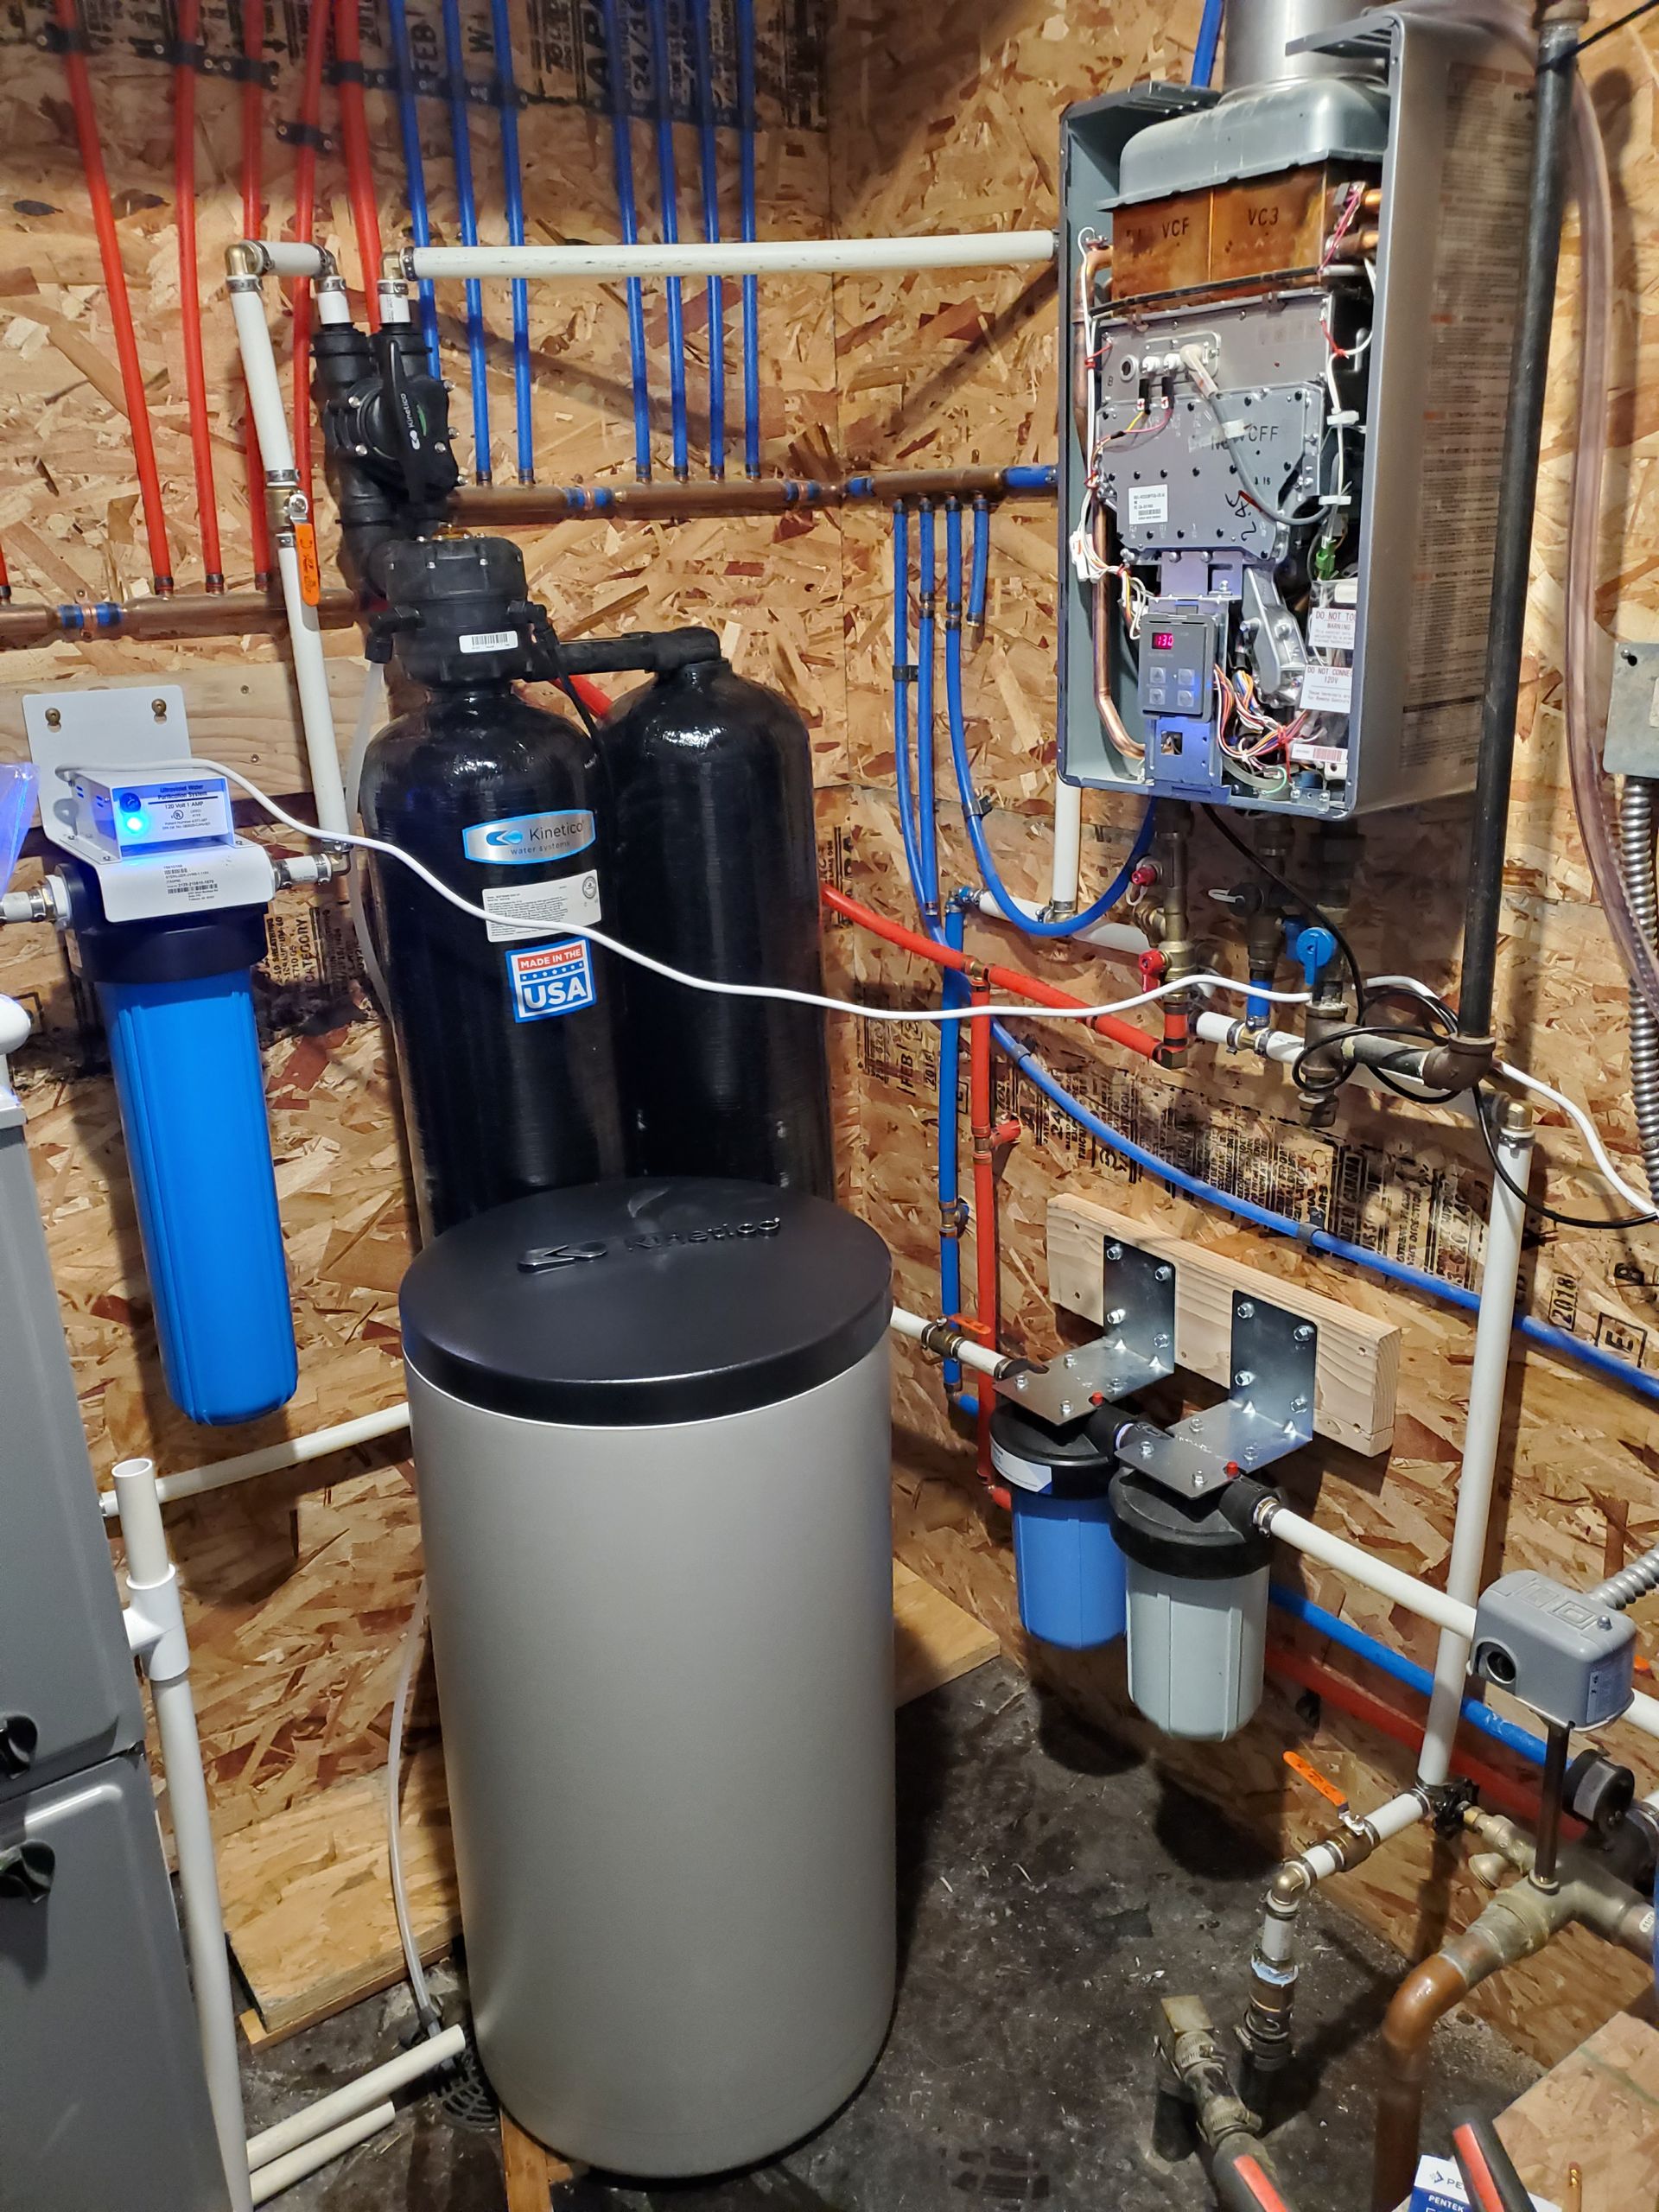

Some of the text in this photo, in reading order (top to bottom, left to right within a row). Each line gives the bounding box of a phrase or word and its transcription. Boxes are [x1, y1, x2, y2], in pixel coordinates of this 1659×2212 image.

[400, 393, 415, 428] Kinetico
[1315, 610, 1356, 621] DO NOT TO
[1158, 634, 1173, 646] 130
[188, 790, 208, 798] System
[529, 822, 584, 842] Kinetico
[511, 841, 570, 855] water systems
[296, 918, 315, 983] CATEGORY
[520, 948, 582, 969] MADE IN THE
[524, 976, 587, 1009] USA
[1550, 1276, 1577, 1325] 2018
[1604, 1330, 1633, 1353] E
[1446, 2177, 1465, 2191] PE
[1428, 2194, 1465, 2212] PENTEK
